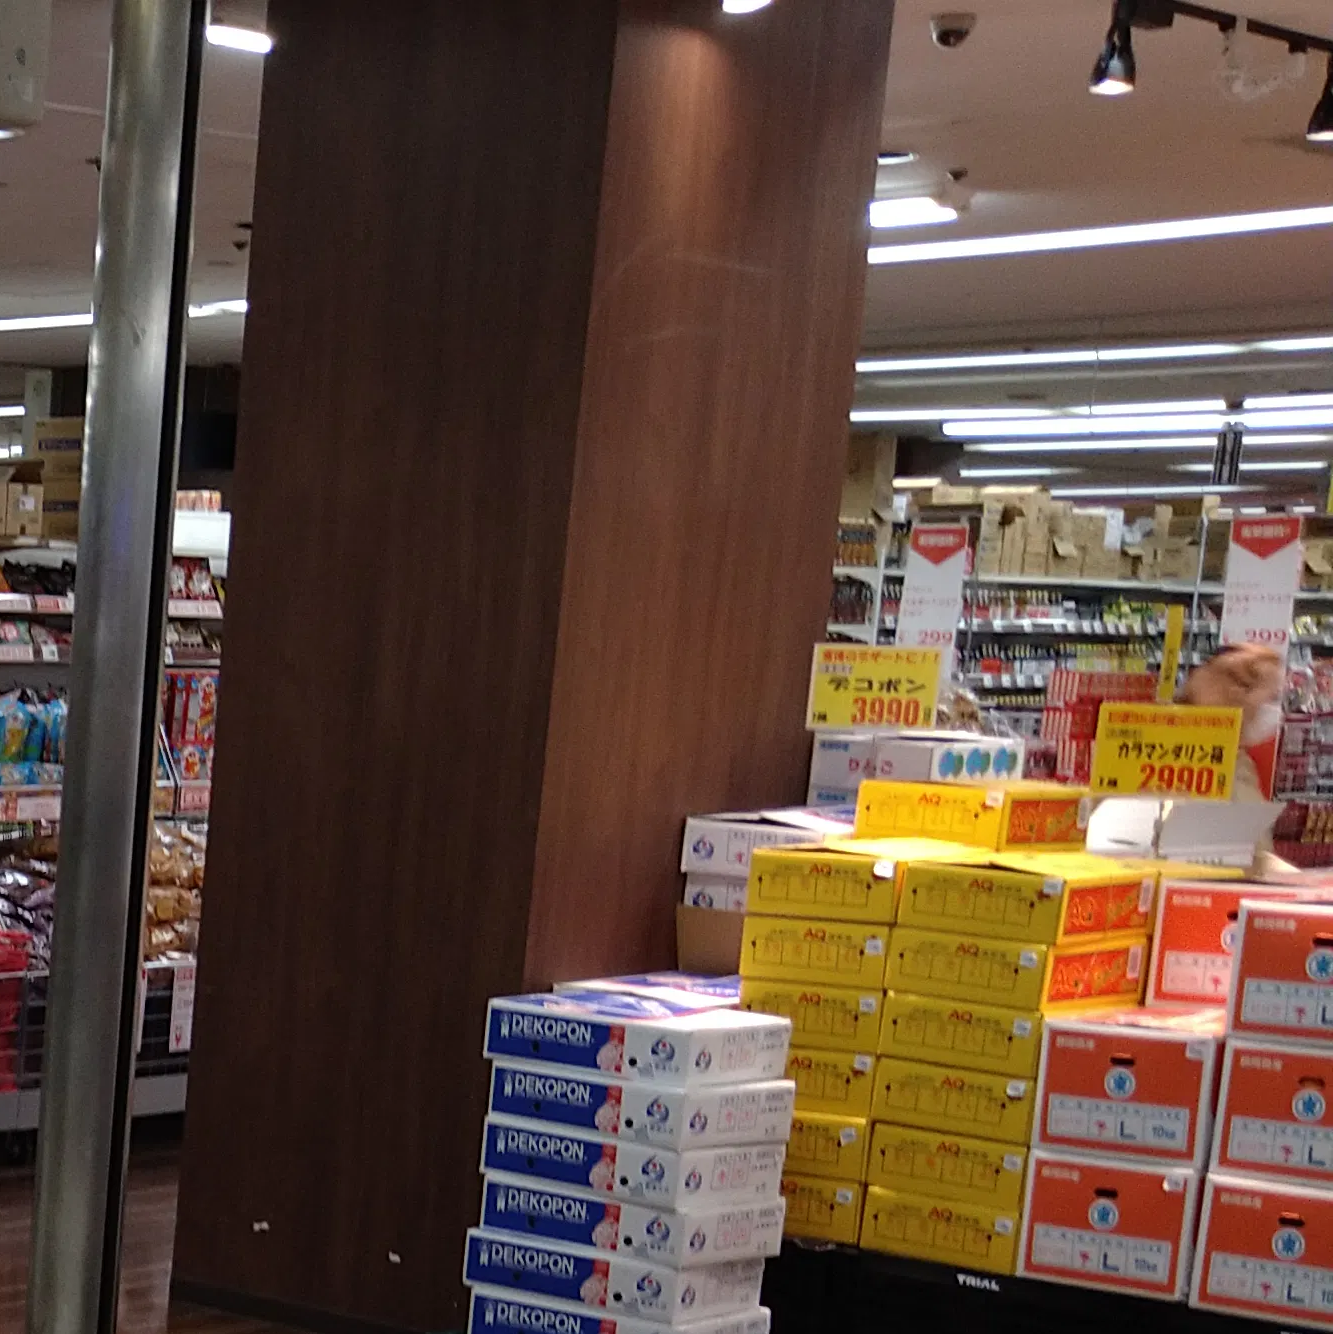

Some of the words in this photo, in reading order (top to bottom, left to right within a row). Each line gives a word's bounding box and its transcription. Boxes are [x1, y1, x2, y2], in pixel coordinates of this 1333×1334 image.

[828, 676, 926, 694] デコポン
[851, 696, 920, 728] 3990
[1138, 763, 1214, 796] 2990
[511, 1013, 593, 1046] DEKOPON
[515, 1072, 591, 1106] DEKOPON
[507, 1129, 584, 1162] DEKOPON
[507, 1187, 587, 1221] DEKOPON
[491, 1243, 575, 1277] DEKOPON
[956, 1273, 1000, 1292] TRIAL
